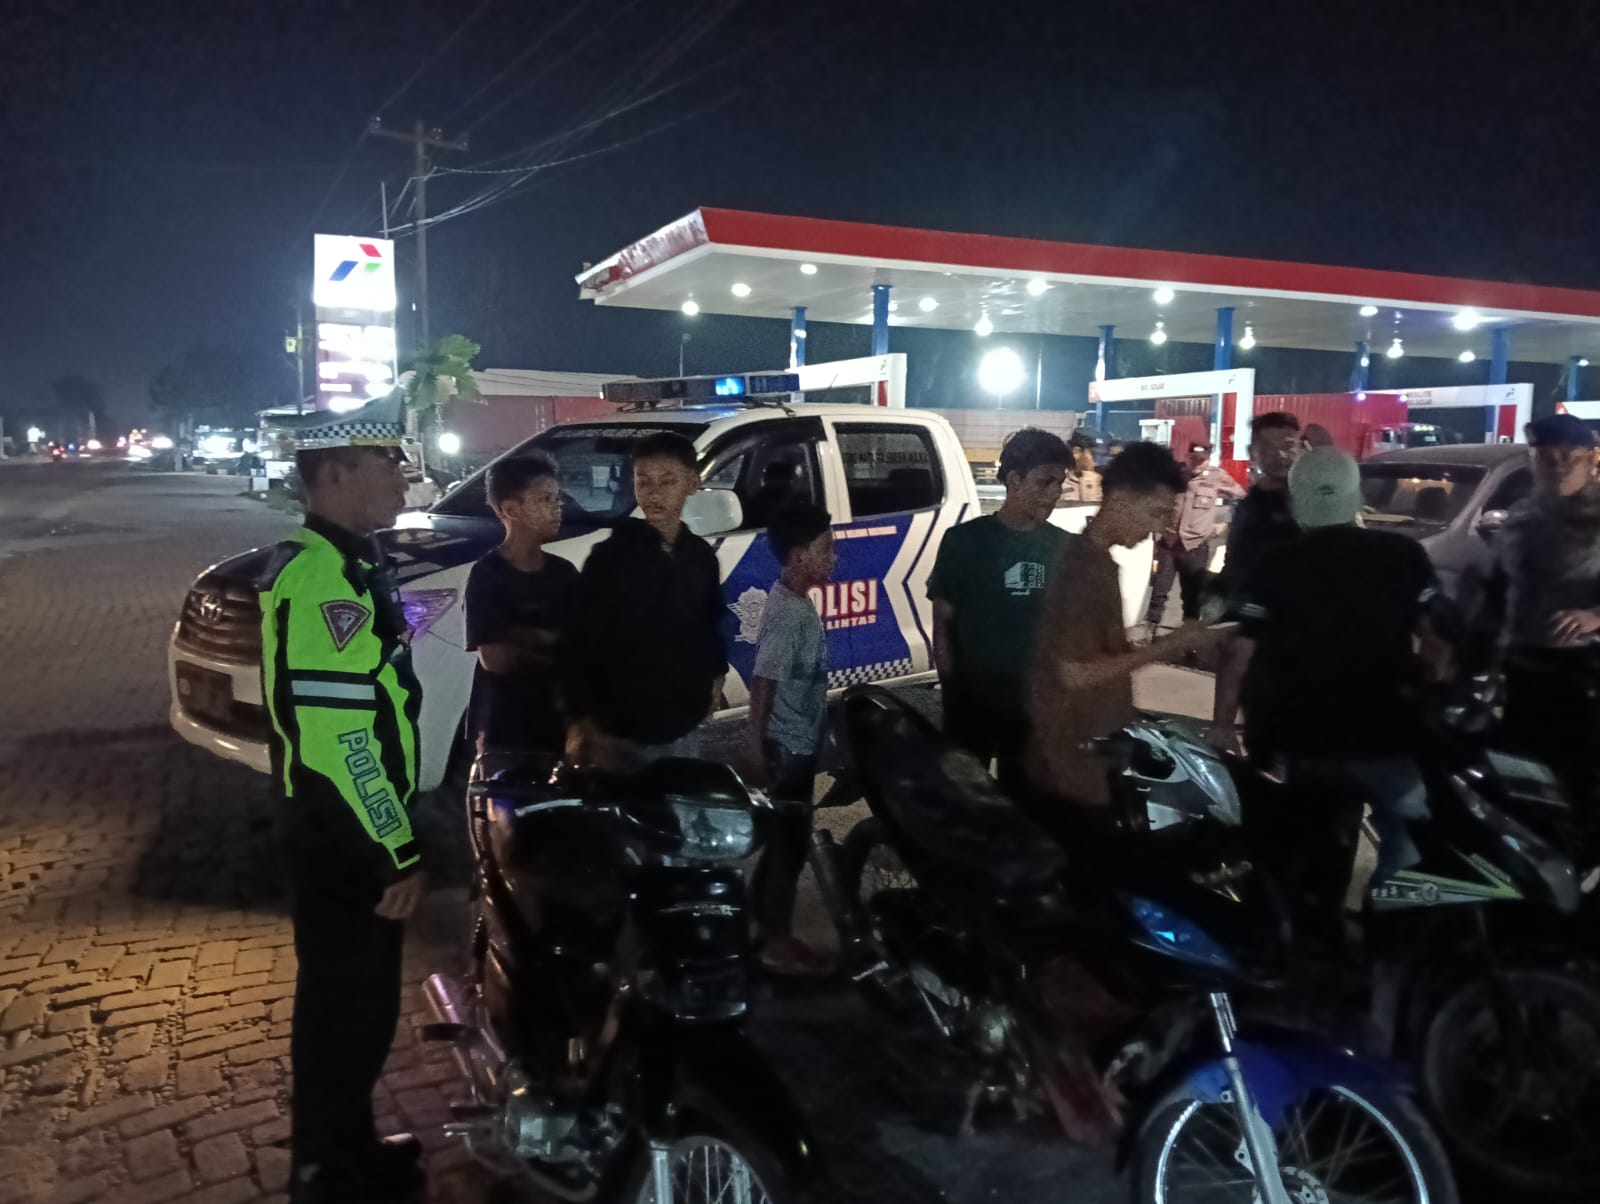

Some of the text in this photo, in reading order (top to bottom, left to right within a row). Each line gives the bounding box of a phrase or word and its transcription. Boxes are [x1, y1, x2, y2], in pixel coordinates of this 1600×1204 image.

[808, 580, 878, 617] OLISI
[827, 614, 877, 630] LINTAS
[338, 728, 402, 839] POLISI
